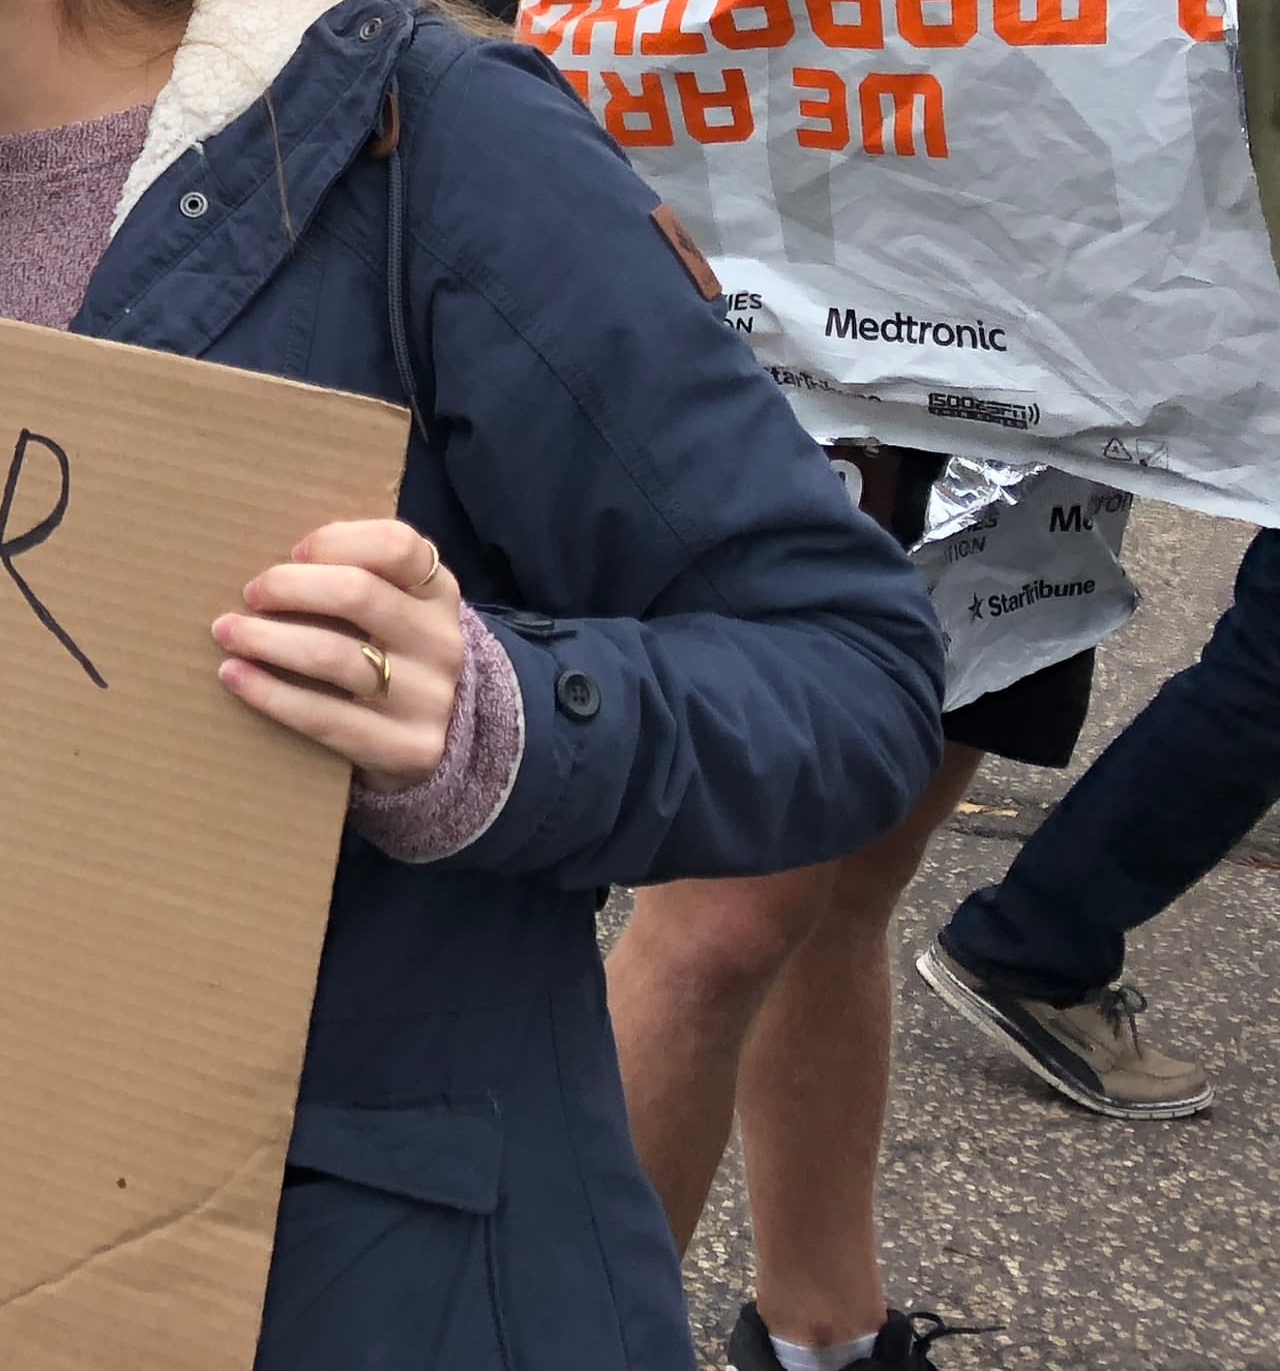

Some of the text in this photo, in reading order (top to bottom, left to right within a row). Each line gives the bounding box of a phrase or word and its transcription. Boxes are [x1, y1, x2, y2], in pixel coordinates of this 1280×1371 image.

[563, 67, 948, 159] WE AR
[824, 307, 1008, 353] Medtronic
[987, 579, 1096, 618] StarTribune
